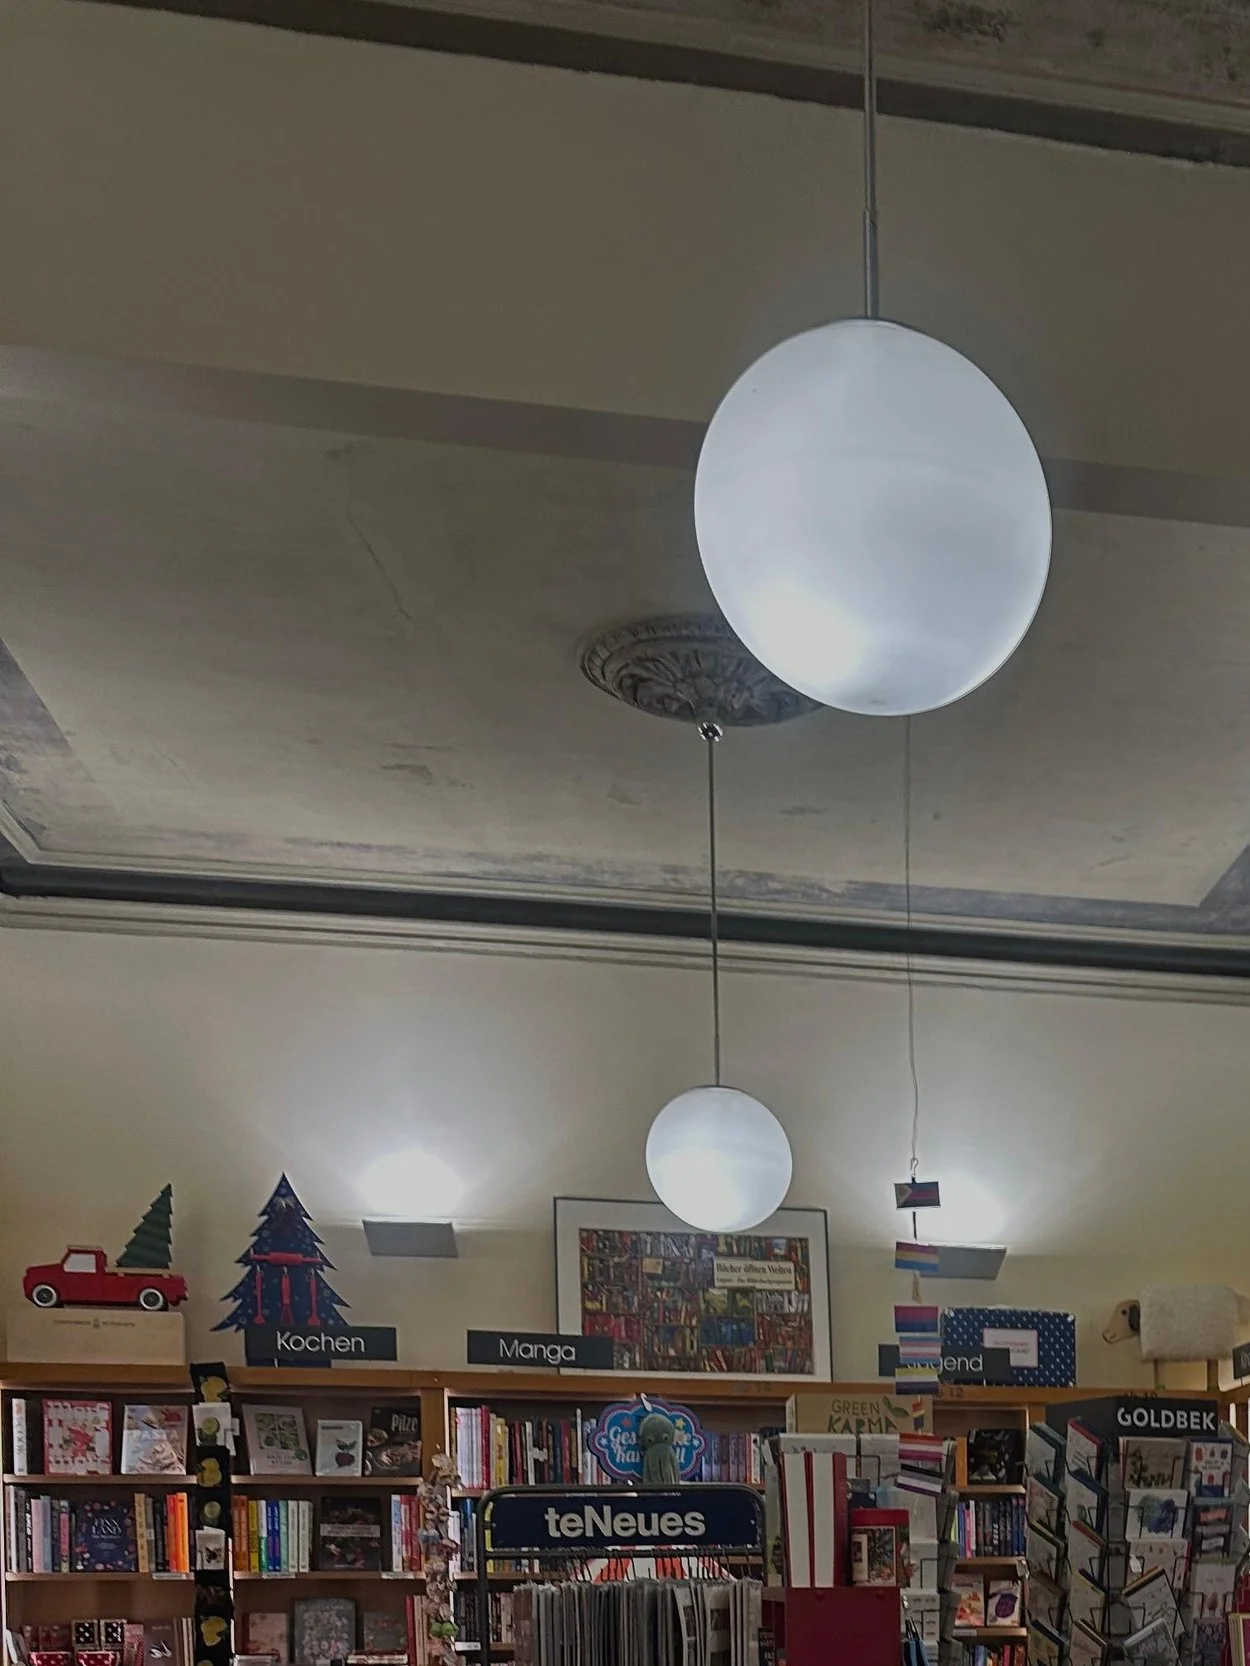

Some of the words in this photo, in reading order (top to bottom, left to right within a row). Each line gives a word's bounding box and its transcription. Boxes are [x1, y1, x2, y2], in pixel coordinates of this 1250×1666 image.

[276, 1330, 365, 1352] Kochen
[499, 1338, 576, 1365] Manga
[832, 1399, 880, 1415] GREEN
[827, 1414, 898, 1434] KARMA
[1117, 1407, 1216, 1431] GOLDBEK
[544, 1504, 706, 1538] teNeues
